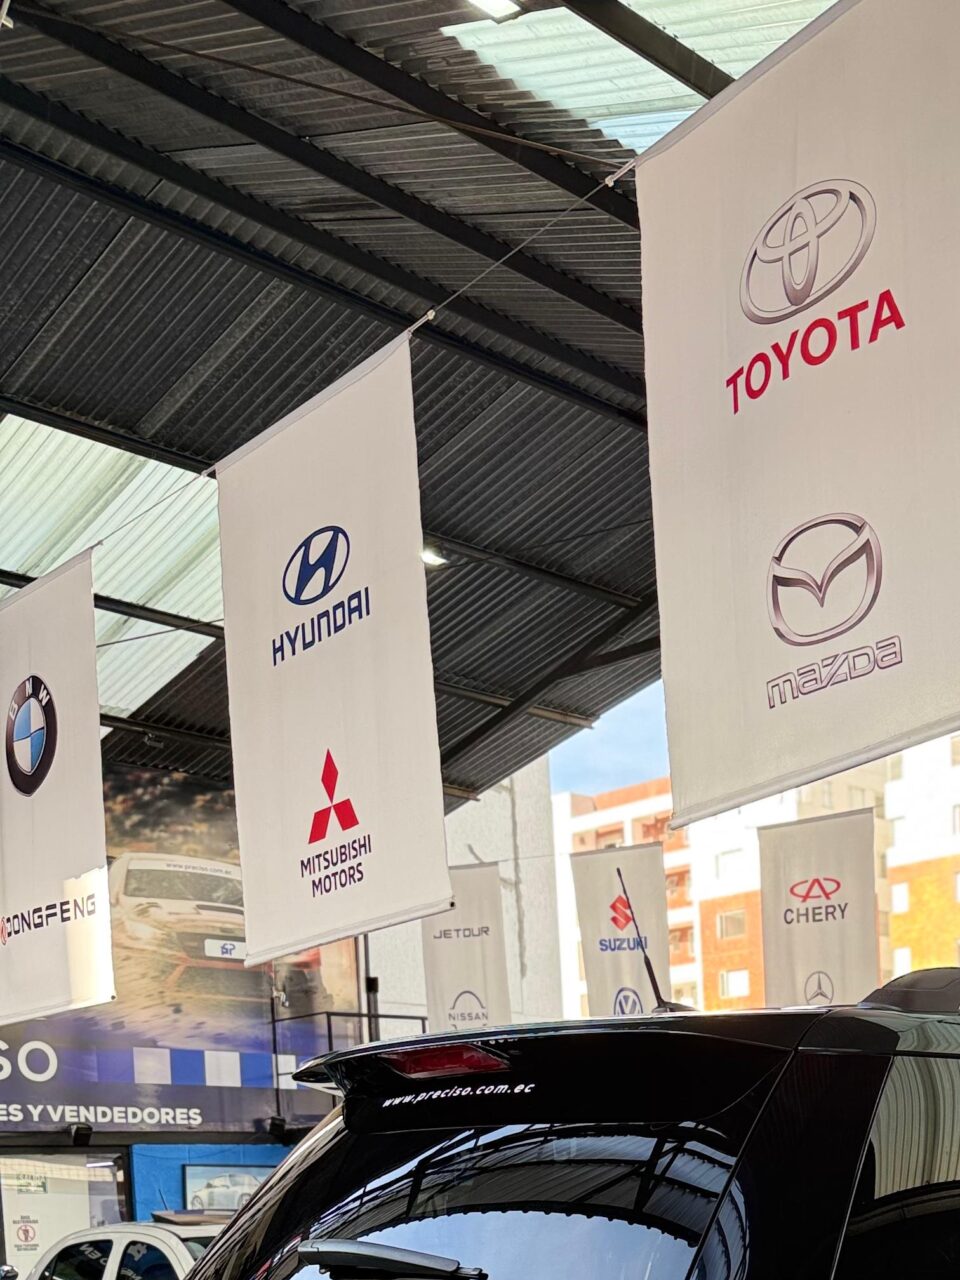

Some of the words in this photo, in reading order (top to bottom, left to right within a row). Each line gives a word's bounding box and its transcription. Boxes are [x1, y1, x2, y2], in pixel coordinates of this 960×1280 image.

[726, 289, 905, 415] TOYOTA
[272, 587, 370, 666] HYUNDAI
[300, 834, 373, 878] MITSUBISHI
[311, 862, 365, 897] MOTORS
[5, 893, 97, 938] DONGFENG
[783, 902, 849, 925] CHERY
[433, 926, 490, 940] JETOUR
[599, 935, 648, 952] SUZUKI
[448, 1011, 489, 1022] NISSAN
[382, 1083, 535, 1108] www.preciso.com.ec
[28, 1104, 43, 1122] Y
[47, 1105, 203, 1125] VENDEDORES
